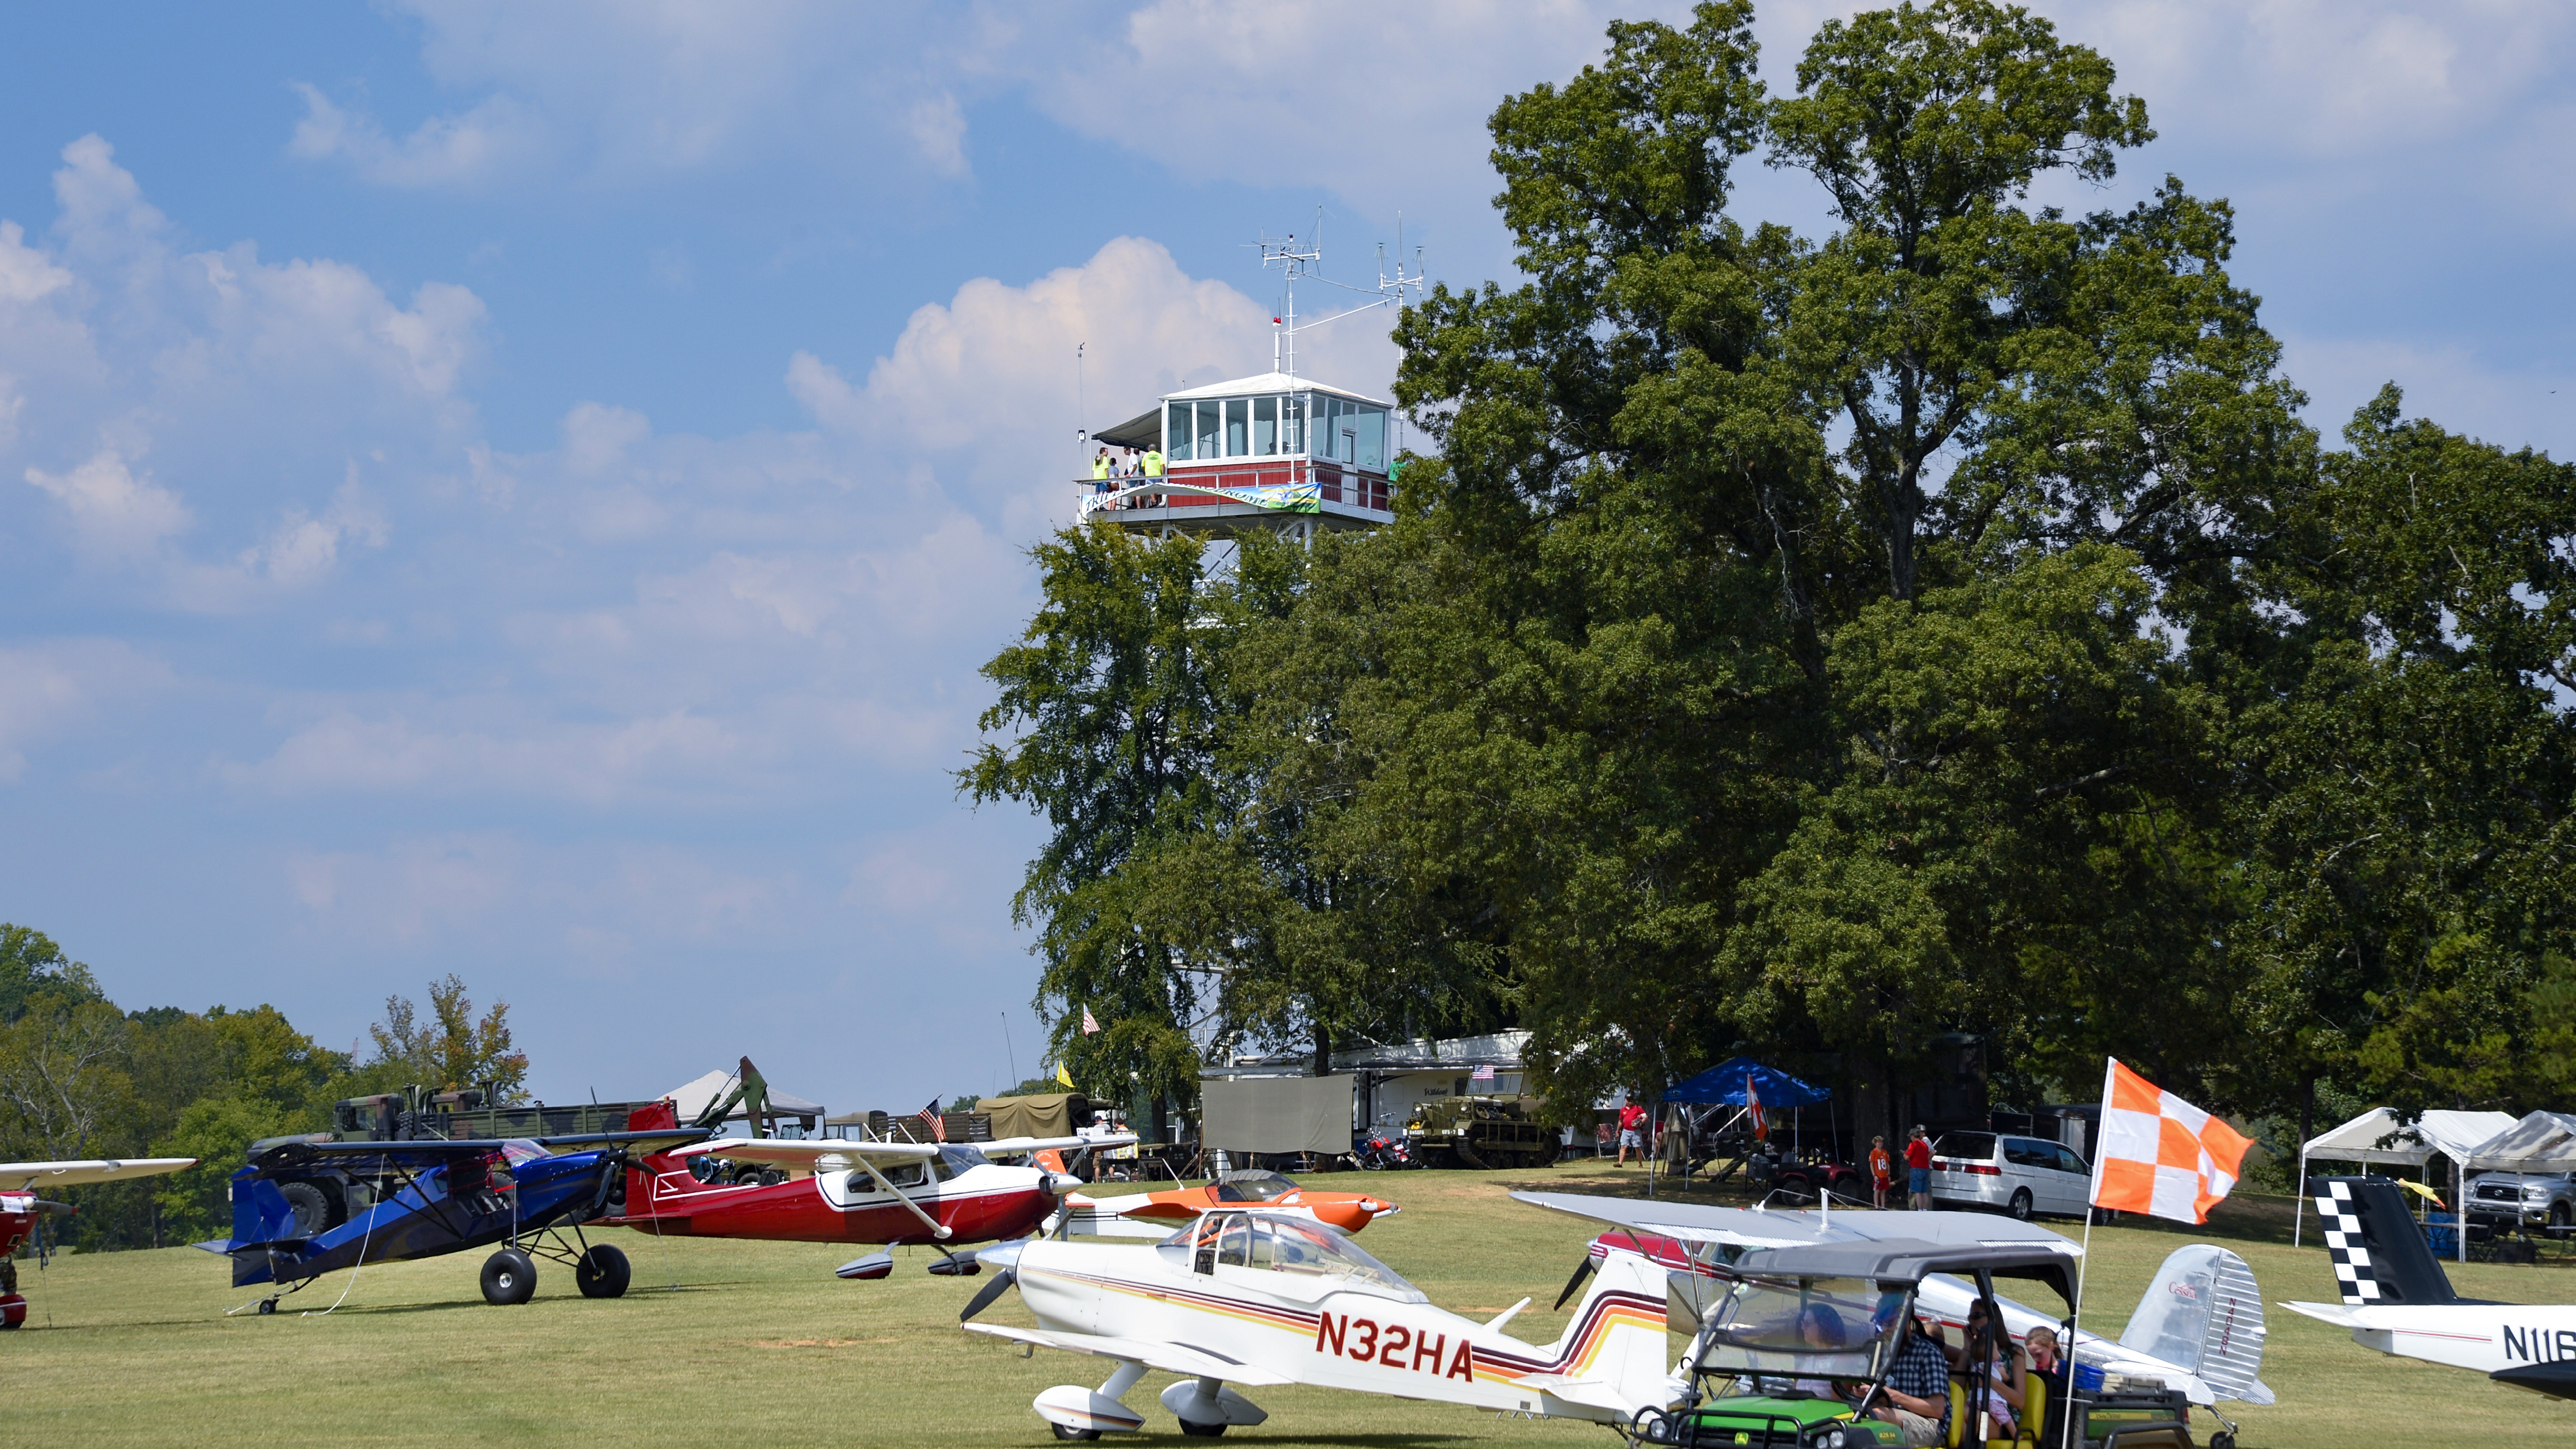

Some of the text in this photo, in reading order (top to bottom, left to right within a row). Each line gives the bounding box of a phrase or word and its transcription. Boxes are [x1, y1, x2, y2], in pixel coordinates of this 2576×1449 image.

[1877, 1159, 1887, 1170] 18
[2168, 1281, 2197, 1299] Cessna
[1316, 1310, 1473, 1383] N32HA
[2219, 1297, 2236, 1356] N4048N
[2503, 1324, 2576, 1364] N116
